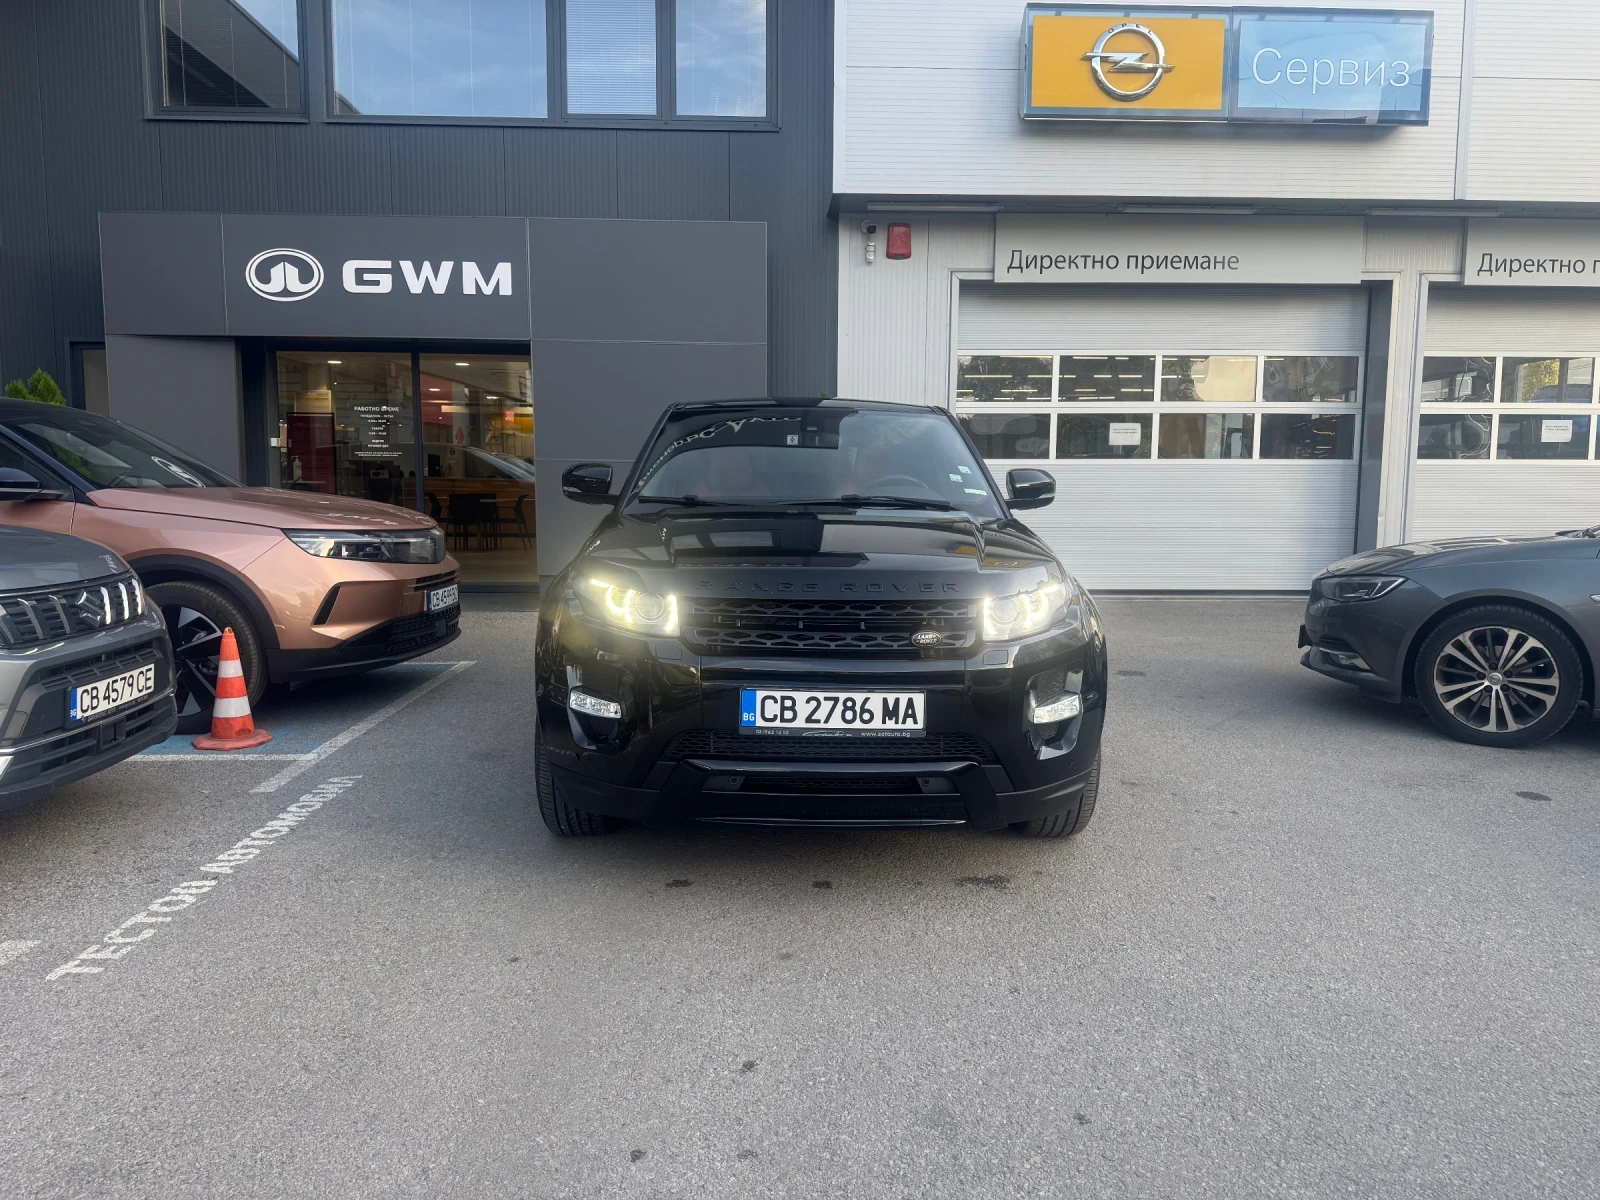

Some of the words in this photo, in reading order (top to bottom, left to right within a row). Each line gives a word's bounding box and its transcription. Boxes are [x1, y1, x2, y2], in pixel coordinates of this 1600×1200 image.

[1107, 23, 1153, 35] OPEL
[1252, 47, 1410, 95] Сервиз
[1007, 249, 1120, 274] Директно
[1126, 254, 1240, 274] приемане
[1477, 253, 1586, 277] Директно
[342, 260, 512, 296] GWM
[696, 581, 818, 593] RANGE
[840, 582, 961, 593] ROVER
[80, 686, 100, 713] CB
[103, 674, 135, 705] 4579
[136, 667, 152, 693] CE
[743, 712, 755, 721] BG
[760, 694, 798, 724] CB
[804, 695, 875, 725] 2786
[881, 696, 919, 726] MA
[200, 775, 364, 874] АВТОМОБИЛ
